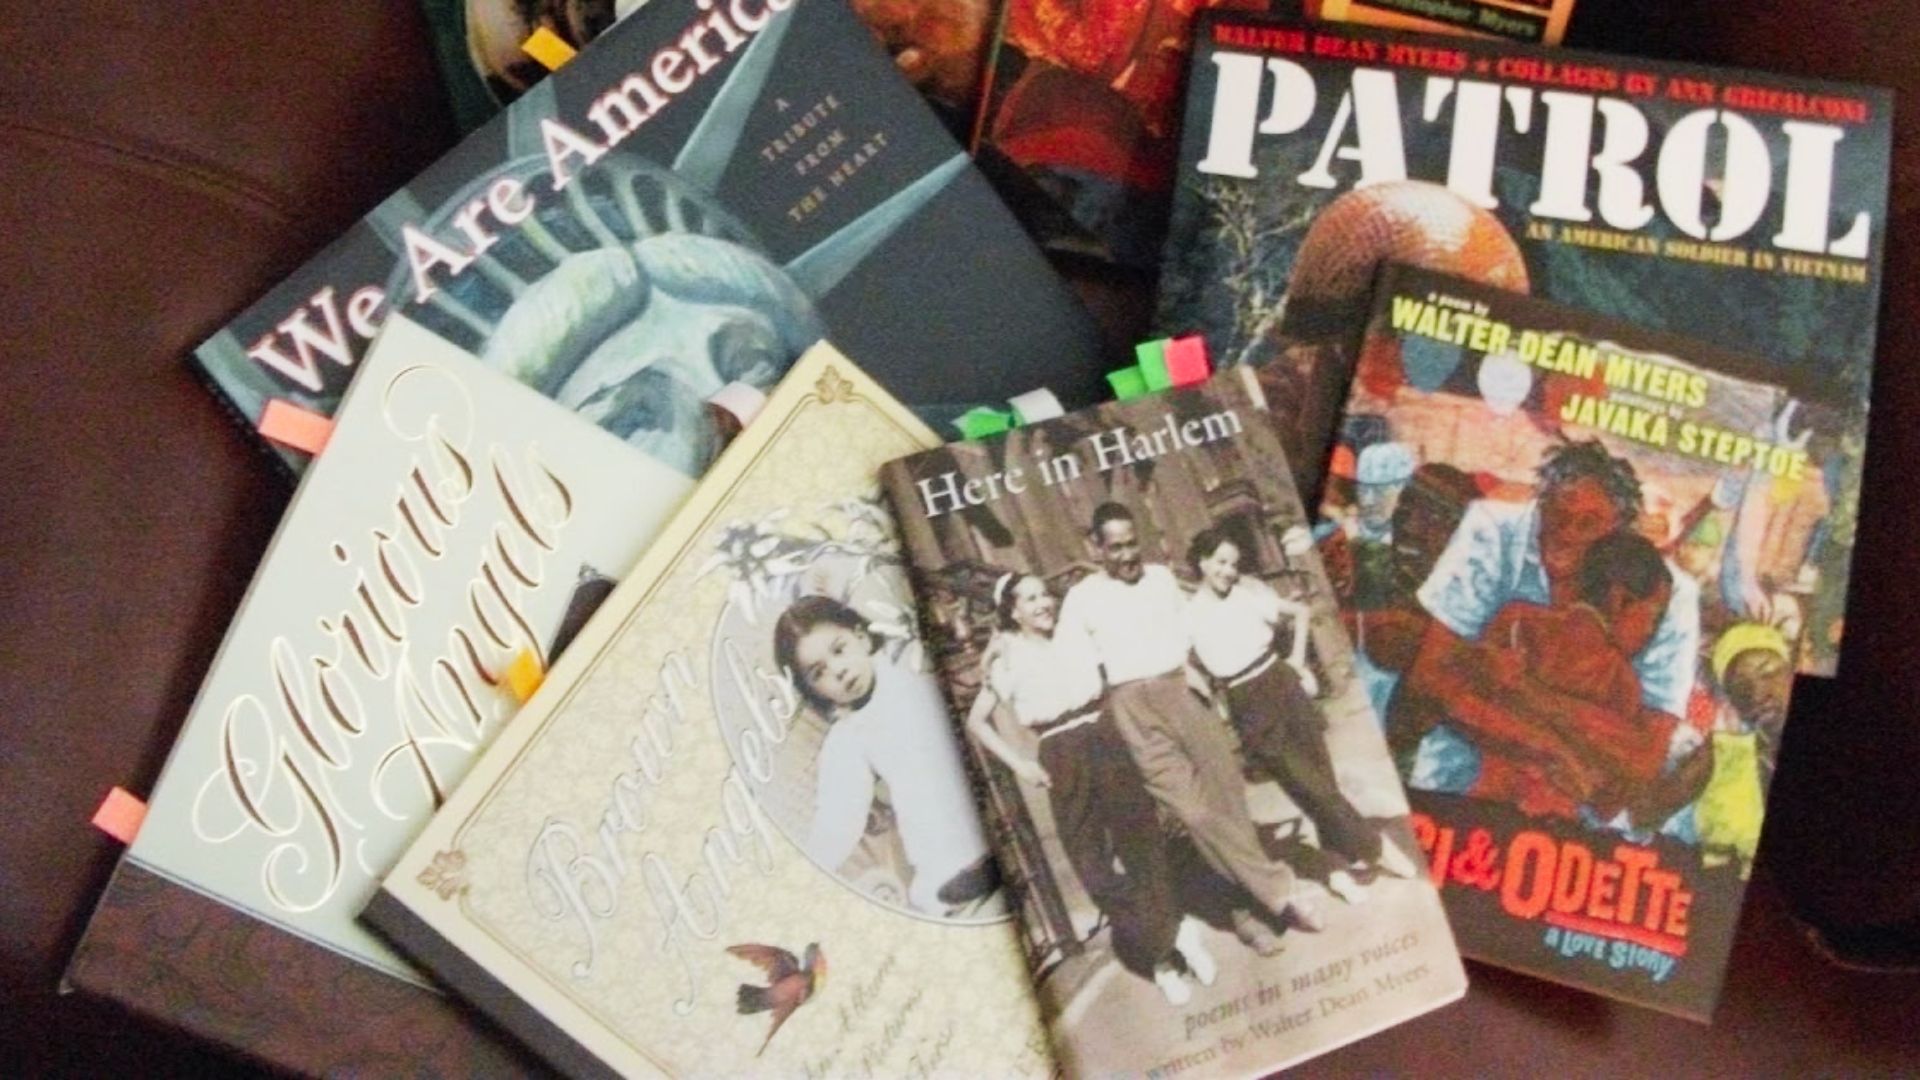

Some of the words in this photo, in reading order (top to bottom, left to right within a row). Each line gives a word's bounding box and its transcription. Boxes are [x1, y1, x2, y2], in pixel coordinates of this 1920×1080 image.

[774, 98, 791, 112] A
[1212, 23, 1305, 53] WALTER
[1313, 34, 1376, 60] DEAN
[1386, 43, 1466, 72] MYERS
[1498, 57, 1618, 91] COLLAGES
[1624, 73, 1657, 95] BY
[1665, 79, 1715, 102] ANN
[761, 95, 840, 162] TRIBUTE
[787, 186, 827, 222] THE
[829, 132, 888, 187] HEART
[794, 130, 846, 175] FROM
[1197, 50, 1871, 258] PATROL
[248, 285, 388, 392] We
[400, 176, 534, 302] Are
[539, 0, 798, 191] Americ
[1526, 221, 1552, 240] AN
[1560, 226, 1658, 255] AMERICAN
[1664, 241, 1748, 267] SOLDIER
[1752, 252, 1774, 270] IN
[1780, 255, 1868, 283] VIETNAM
[1391, 295, 1512, 355] WALTER
[1517, 330, 1602, 380] DEAN
[1604, 352, 1708, 408] MYERS
[916, 459, 1028, 519] Here
[1037, 448, 1081, 486] in
[1088, 408, 1245, 473] Harlem
[1560, 393, 1670, 447] JAVAKA
[1678, 422, 1808, 482] STEPTOE
[193, 364, 475, 914] Glorious
[371, 441, 573, 815] Angels
[526, 650, 699, 979] Brown
[641, 637, 801, 1017] Angels
[1146, 1046, 1216, 1080] written
[1221, 1032, 1247, 1052] by
[1248, 1008, 1313, 1042] Walter
[1319, 990, 1371, 1019] Dean
[1374, 961, 1431, 996] Myers
[1183, 993, 1252, 1041] poems
[1256, 978, 1283, 1008] in
[1290, 957, 1355, 993] many
[1361, 931, 1420, 965] voices
